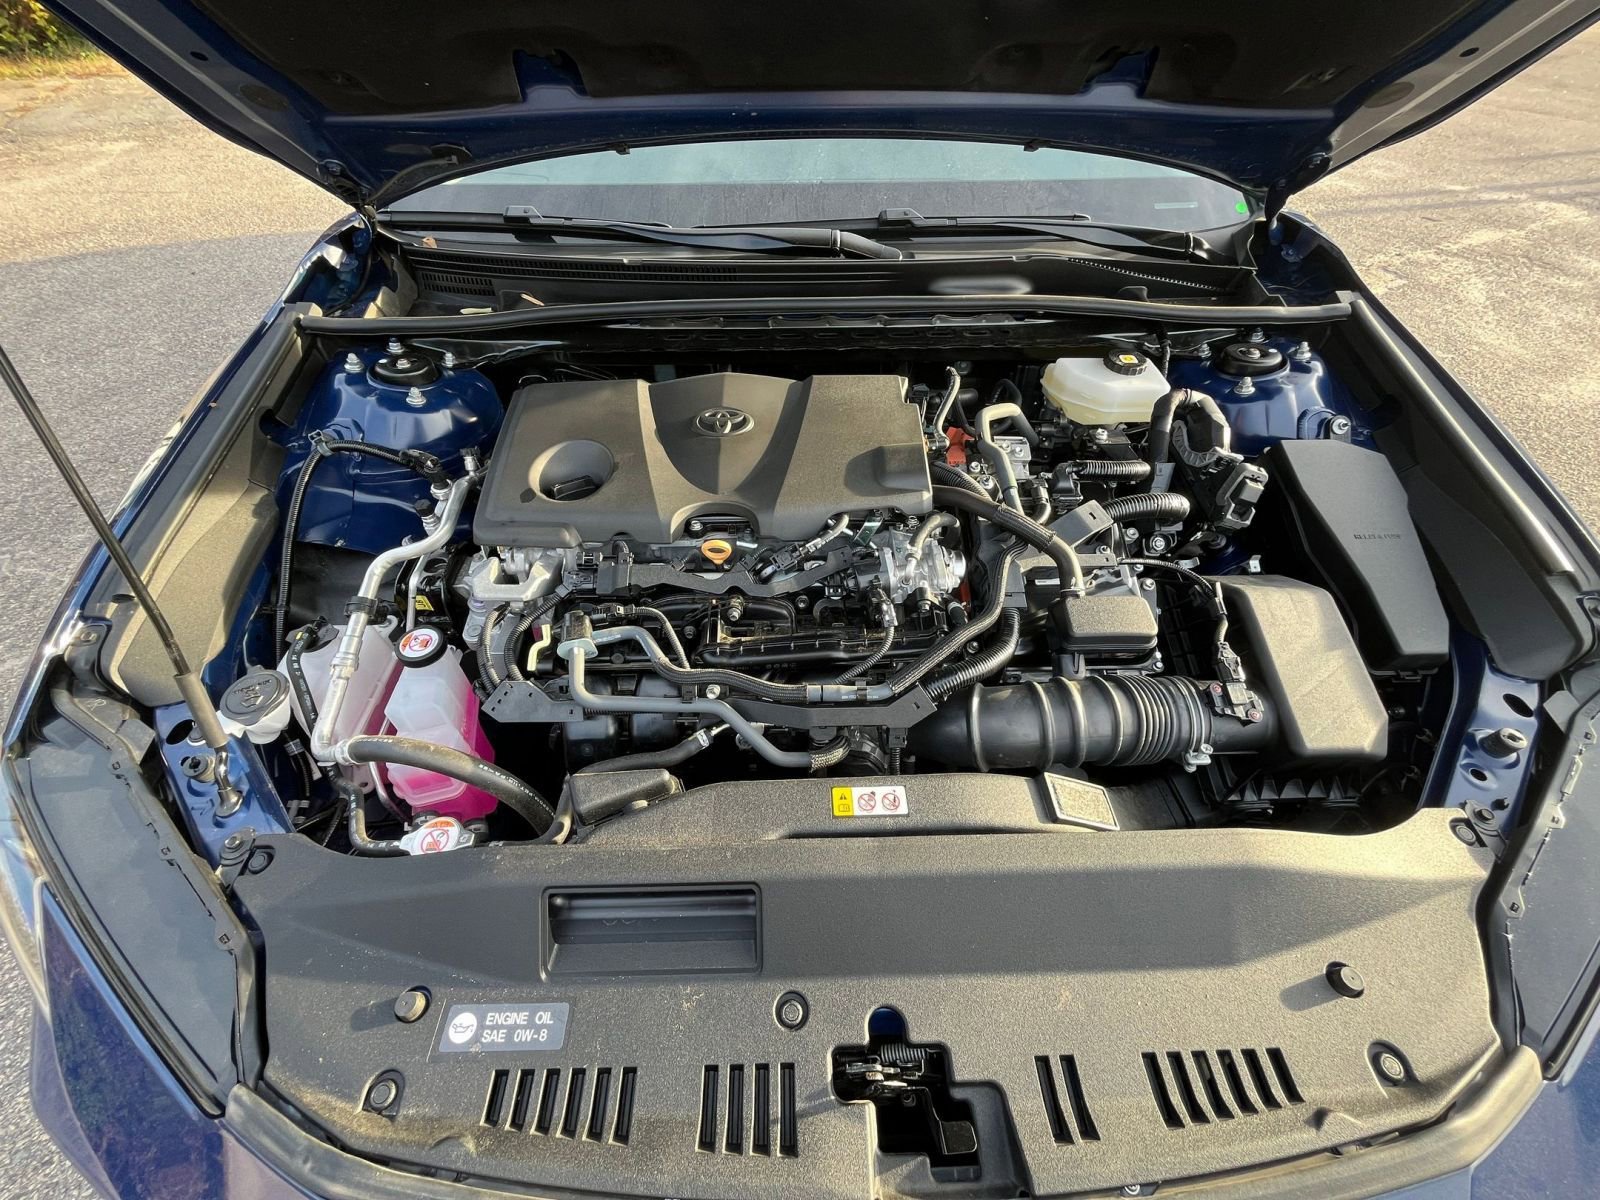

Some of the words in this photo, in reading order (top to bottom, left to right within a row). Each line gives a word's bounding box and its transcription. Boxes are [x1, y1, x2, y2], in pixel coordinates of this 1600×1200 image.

[486, 1012, 528, 1025] ENGINE
[535, 1011, 554, 1024] OIL
[481, 1029, 507, 1043] SAE
[514, 1029, 547, 1042] 0W-8
